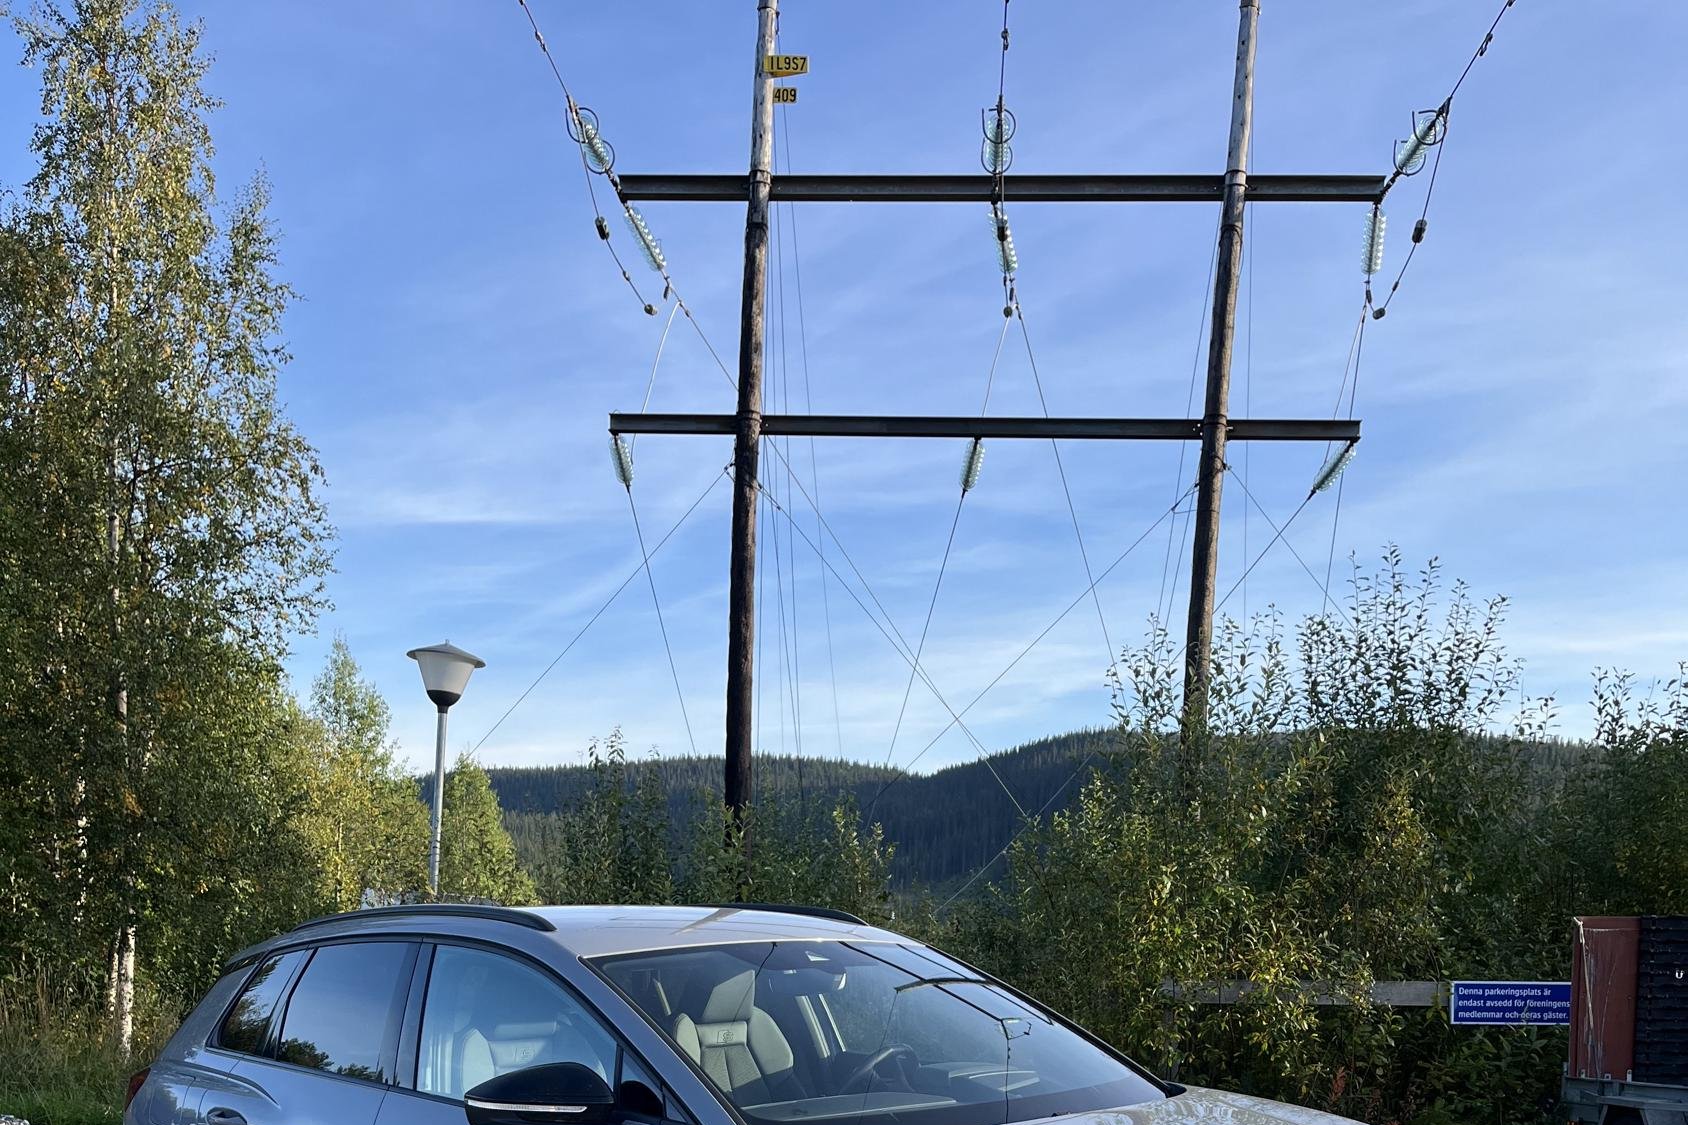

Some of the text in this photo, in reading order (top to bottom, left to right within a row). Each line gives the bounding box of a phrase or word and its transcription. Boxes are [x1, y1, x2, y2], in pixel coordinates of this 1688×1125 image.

[774, 88, 797, 103] 409
[1458, 987, 1551, 997] Denna parkeringsplats är
[1458, 999, 1570, 1009] endast avsedd för föreningens
[1458, 1010, 1503, 1019] medlemmar
[1505, 1011, 1519, 1019] och
[1543, 1011, 1568, 1020] gäster.
